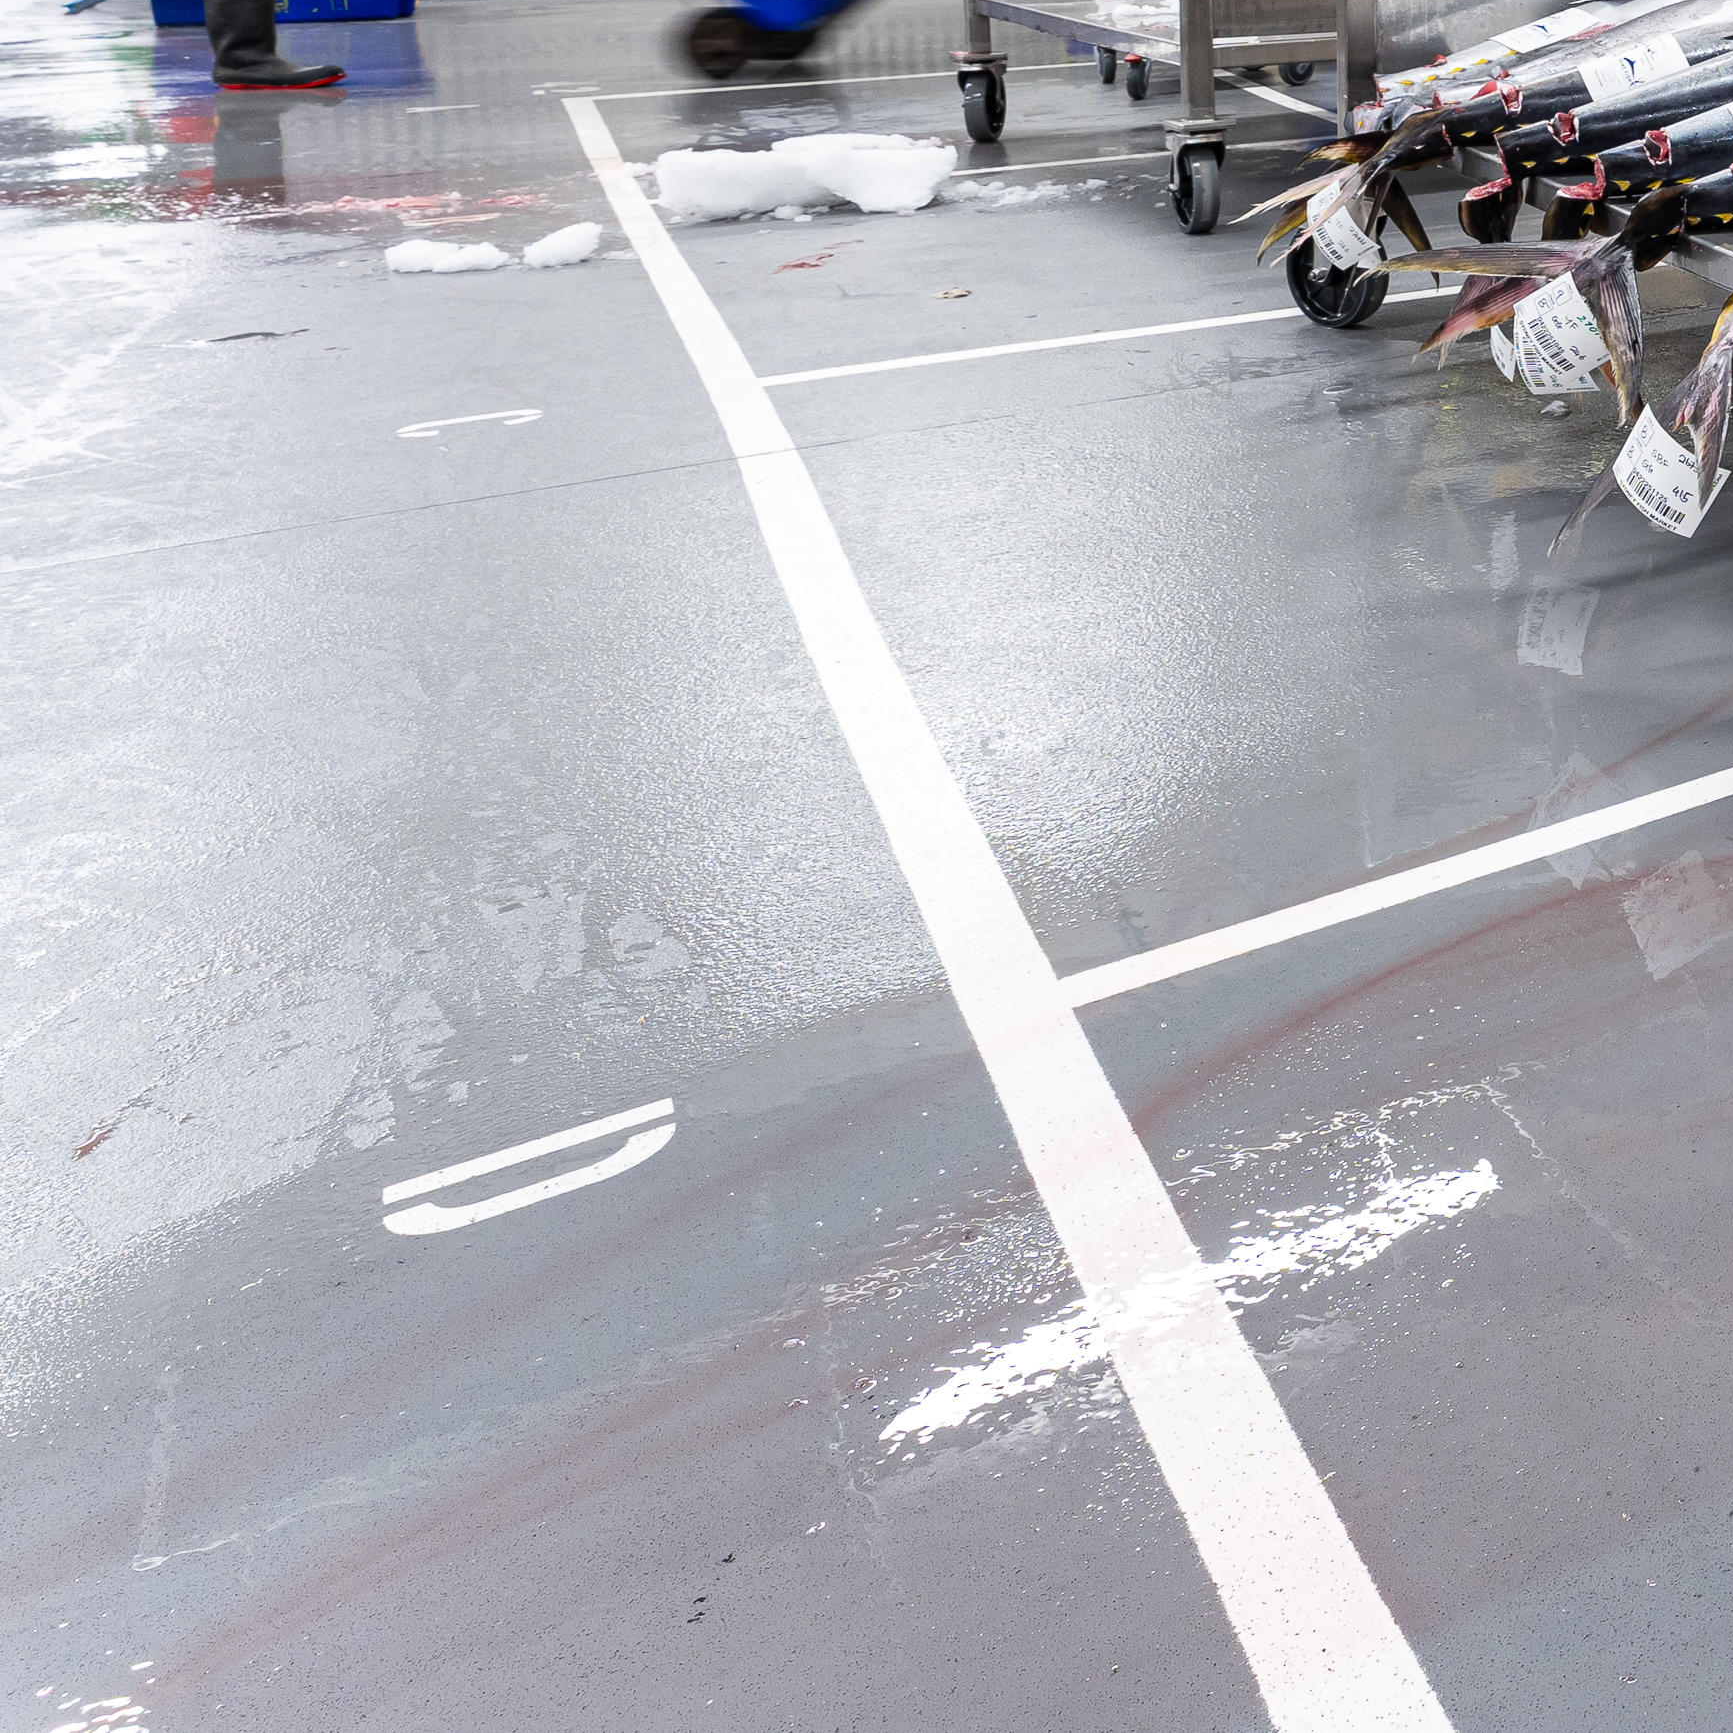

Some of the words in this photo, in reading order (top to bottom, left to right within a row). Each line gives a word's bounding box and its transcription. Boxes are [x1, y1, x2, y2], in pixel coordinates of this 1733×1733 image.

[1542, 357, 1563, 376] MARKET
[1651, 449, 1670, 468] SBF
[1632, 467, 1668, 503] 0422251125
[1636, 502, 1649, 515] FISH
[1650, 514, 1677, 531] MARKET
